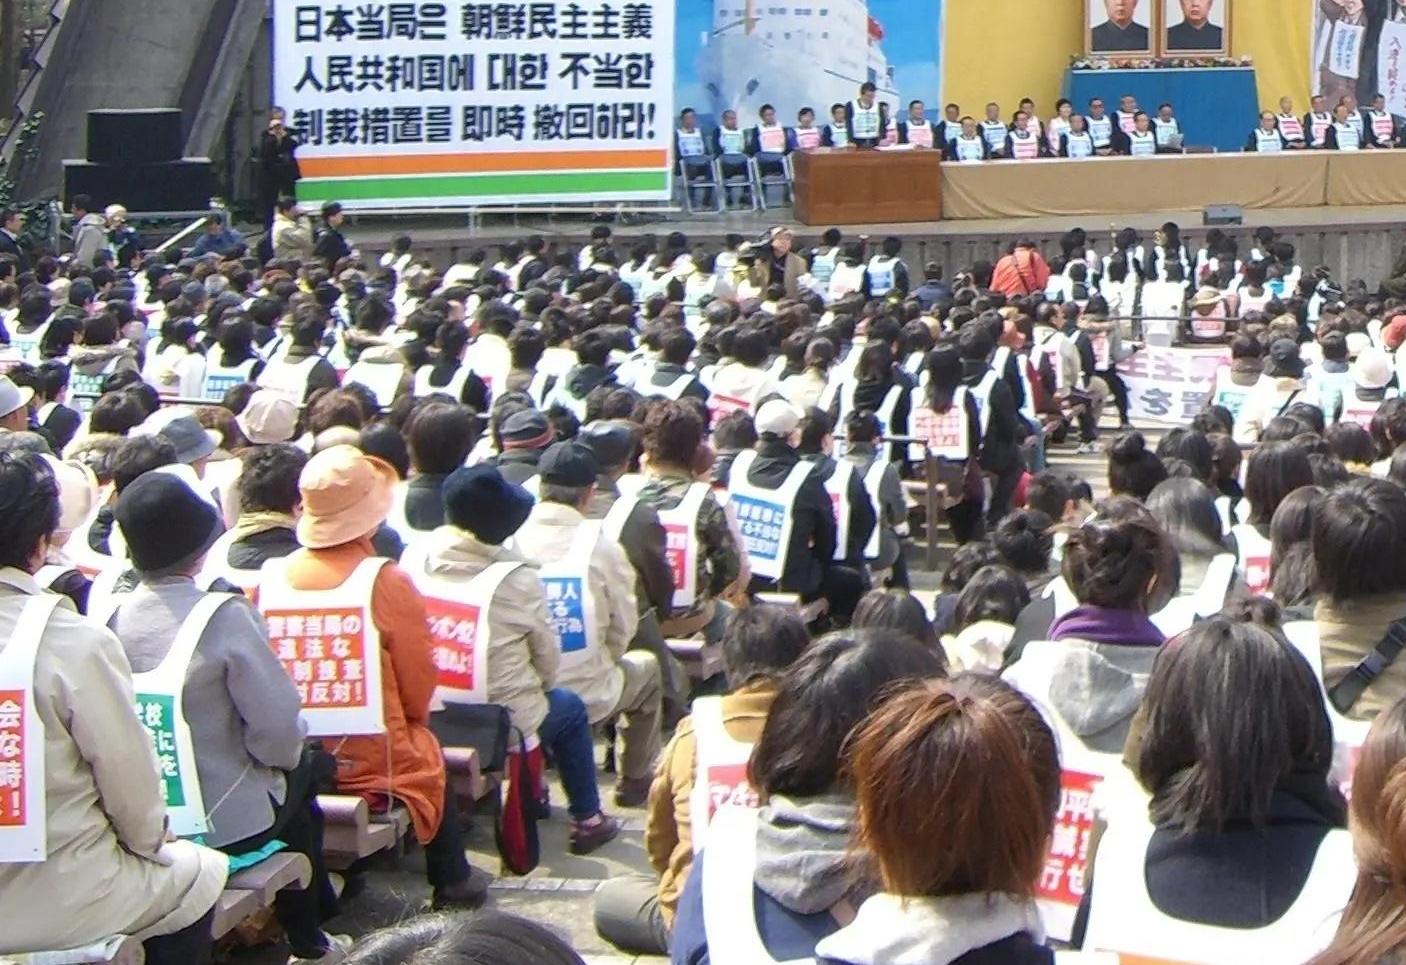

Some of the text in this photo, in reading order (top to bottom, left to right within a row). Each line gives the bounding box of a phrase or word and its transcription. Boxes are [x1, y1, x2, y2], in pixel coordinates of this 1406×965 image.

[294, 3, 652, 42] 日本当局은 朝鮮民主主義
[293, 52, 653, 93] 人民共和国에 대한 不当한
[292, 106, 451, 146] 制裁措置를
[462, 104, 524, 142] 即時
